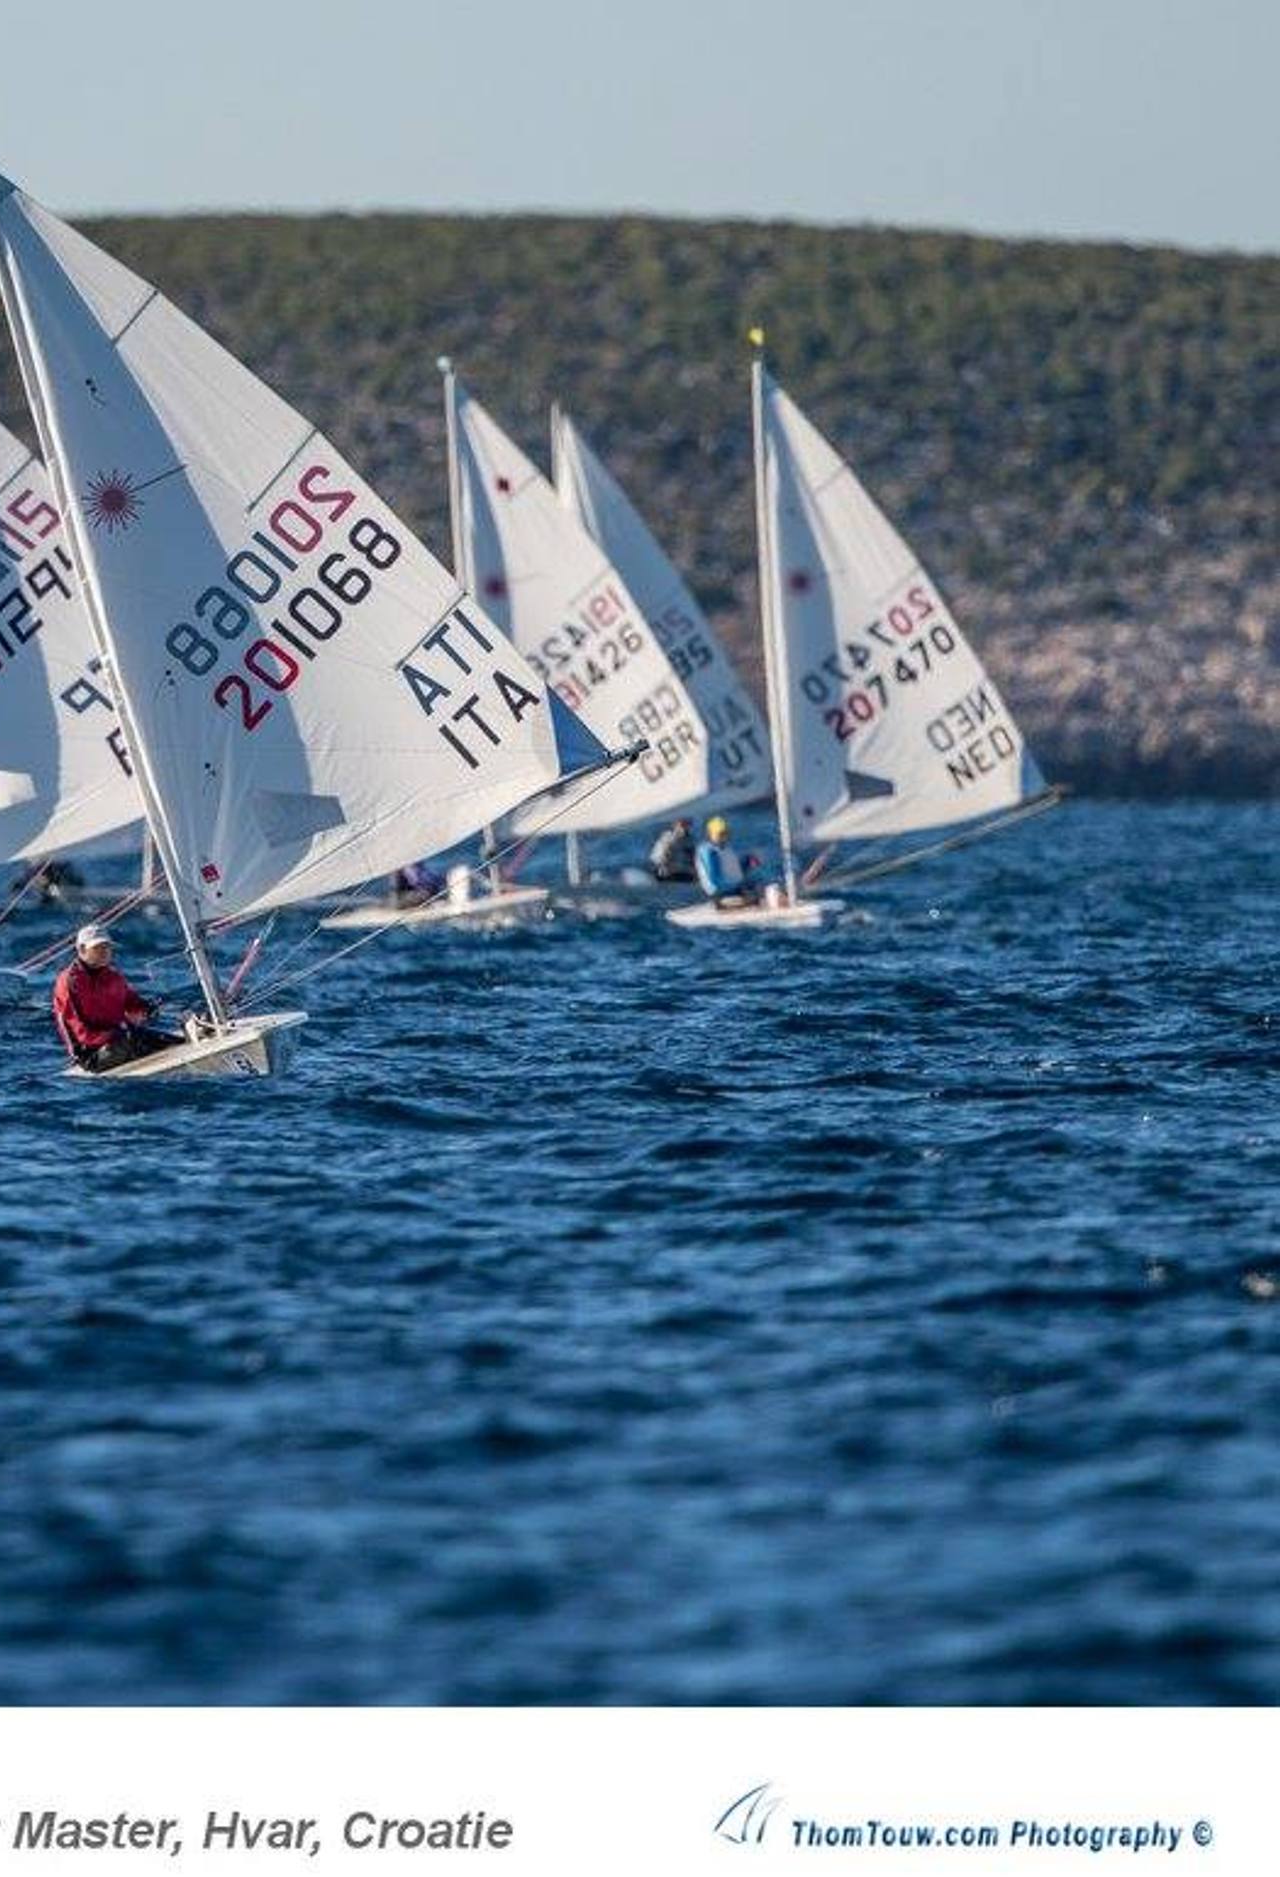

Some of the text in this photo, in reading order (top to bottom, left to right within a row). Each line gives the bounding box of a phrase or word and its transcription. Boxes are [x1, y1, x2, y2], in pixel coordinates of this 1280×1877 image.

[214, 517, 401, 731] 201068
[438, 668, 540, 769] ITA
[824, 625, 955, 741] 207470
[947, 724, 1016, 790] NED
